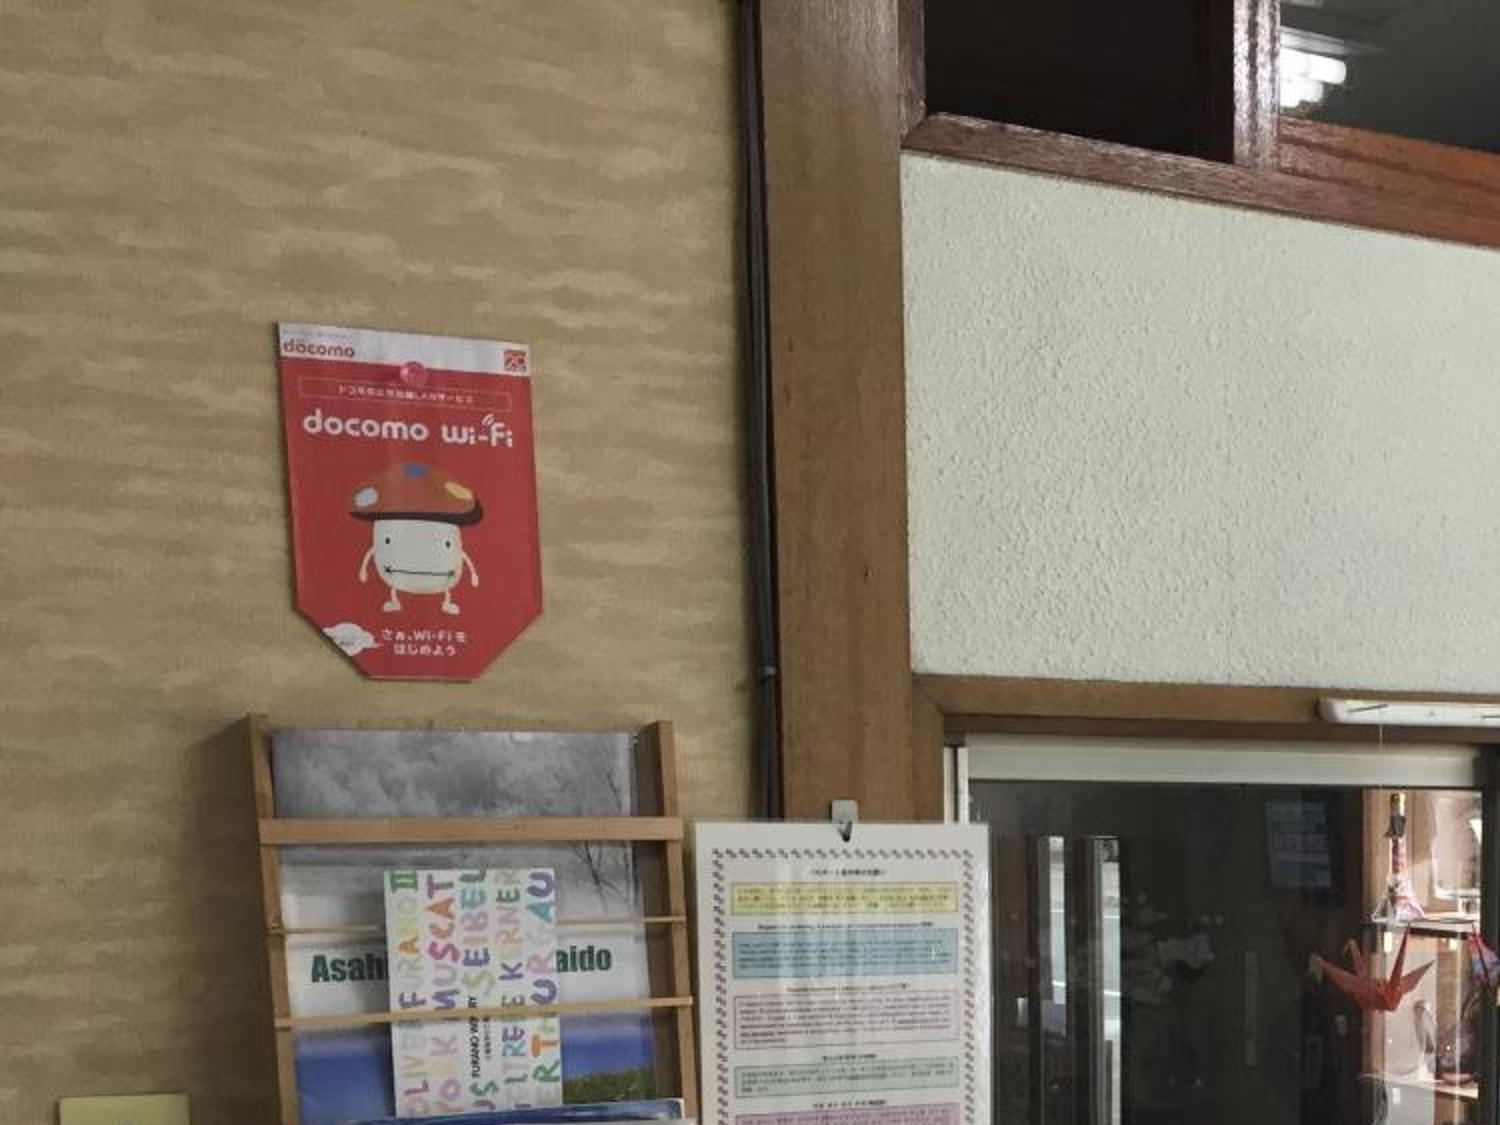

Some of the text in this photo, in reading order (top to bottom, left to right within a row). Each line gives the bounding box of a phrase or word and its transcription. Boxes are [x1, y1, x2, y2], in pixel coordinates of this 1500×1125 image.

[282, 338, 356, 358] docomo
[302, 408, 429, 441] docomo
[311, 944, 612, 983] Asah aido
